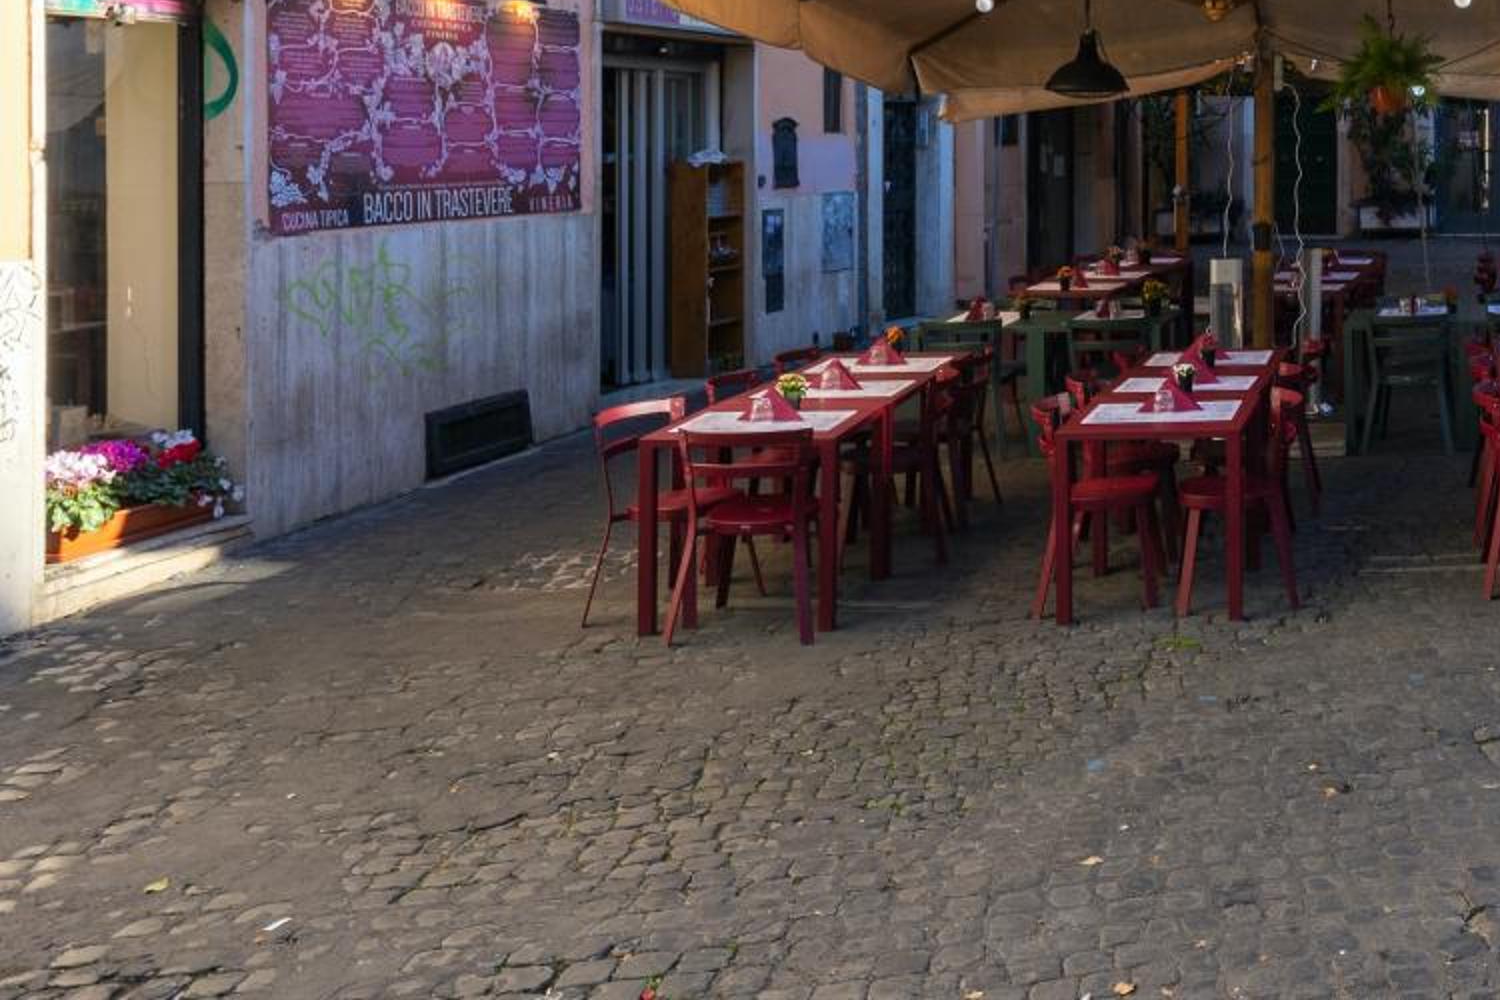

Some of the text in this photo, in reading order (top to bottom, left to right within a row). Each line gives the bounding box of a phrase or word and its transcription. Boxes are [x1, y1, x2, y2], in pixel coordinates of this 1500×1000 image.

[281, 208, 350, 231] CUCINA TIPICA
[363, 187, 514, 224] BACCO IN TRASTEVERE
